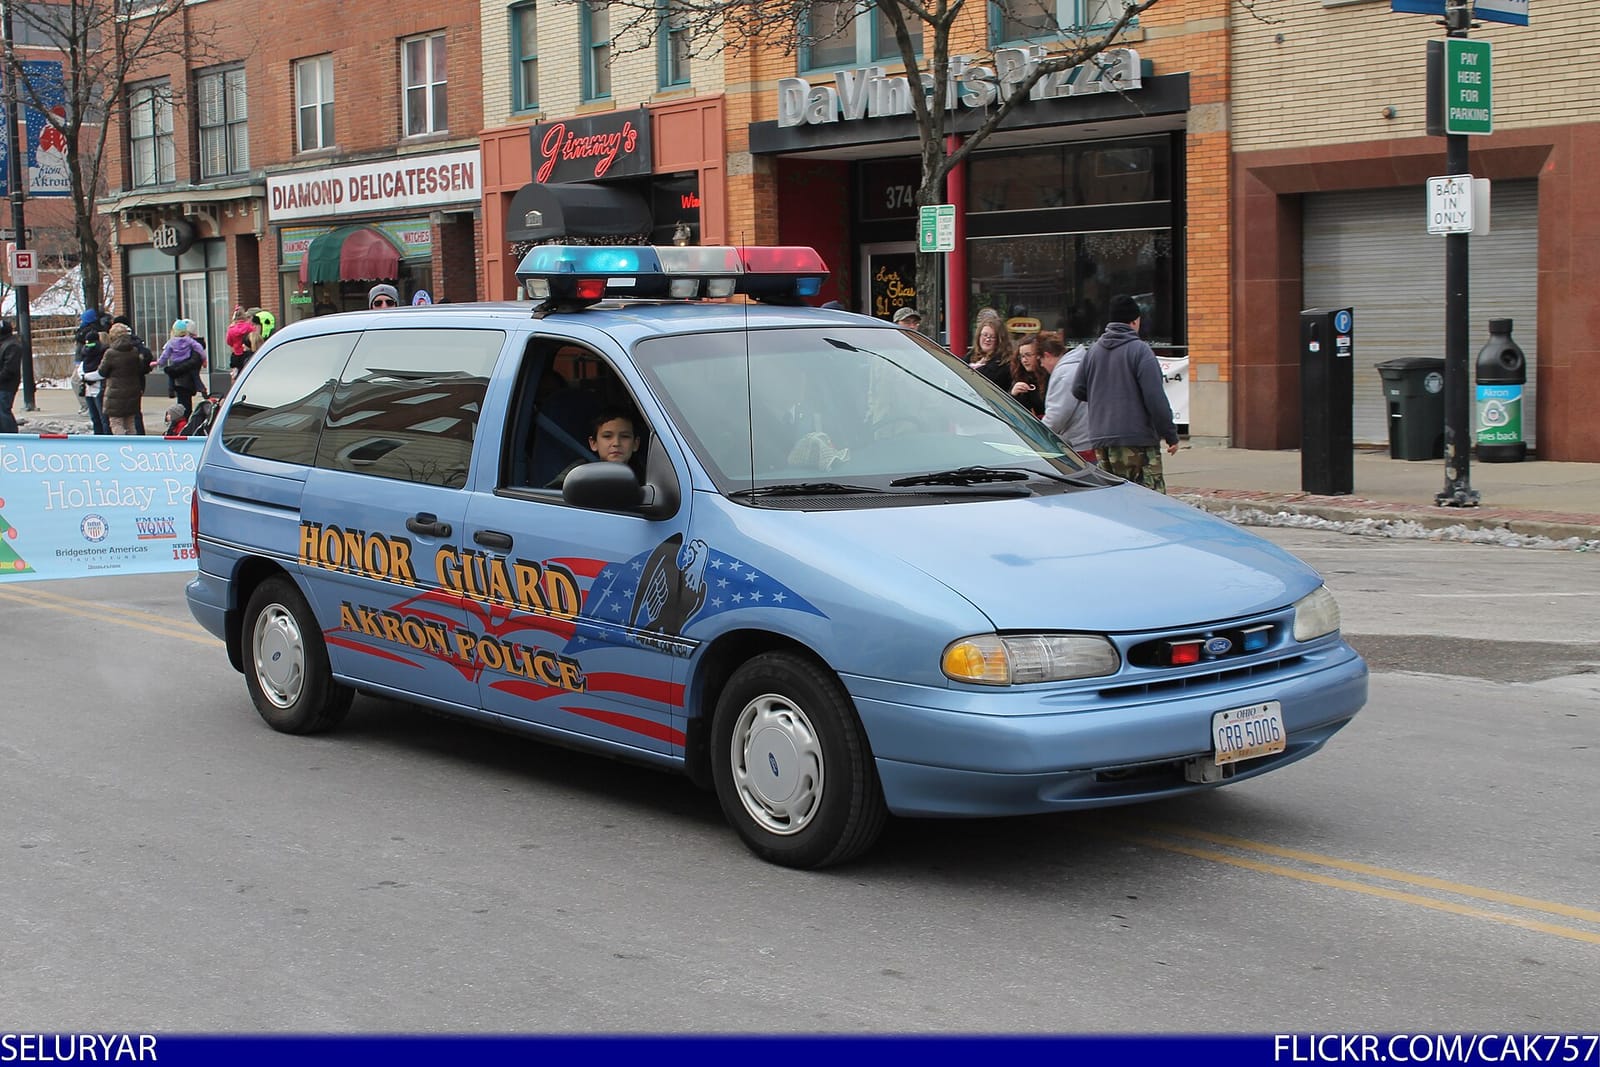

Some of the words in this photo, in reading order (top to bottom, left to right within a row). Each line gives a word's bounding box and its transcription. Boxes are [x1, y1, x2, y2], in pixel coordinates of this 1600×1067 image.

[1460, 52, 1478, 66] PAY
[996, 45, 1142, 105] Pizza
[1457, 70, 1482, 85] HERE
[1460, 89, 1479, 103] FOR
[1450, 107, 1489, 122] PARKING
[537, 121, 638, 184] Jimmy's
[272, 177, 344, 212] DIAMOND
[349, 162, 475, 203] DELICATESSEN
[1435, 182, 1465, 196] BACK
[886, 185, 913, 209] 374
[1443, 198, 1457, 210] IN
[1434, 211, 1467, 225] ONLY
[403, 231, 430, 244] WATCHES
[1496, 431, 1518, 441] back
[119, 445, 196, 473] Santa
[42, 479, 157, 511] Holiday
[136, 521, 176, 536] WQMX
[55, 547, 107, 558] Bridgestone
[109, 545, 149, 554] Americas
[297, 519, 417, 588] HONOR
[434, 544, 585, 622] GUARD
[338, 600, 455, 659] AKRON
[456, 630, 587, 693] POLICE
[1236, 707, 1257, 719] OHIO
[1218, 724, 1243, 753] CRB
[1245, 717, 1280, 747] 5006
